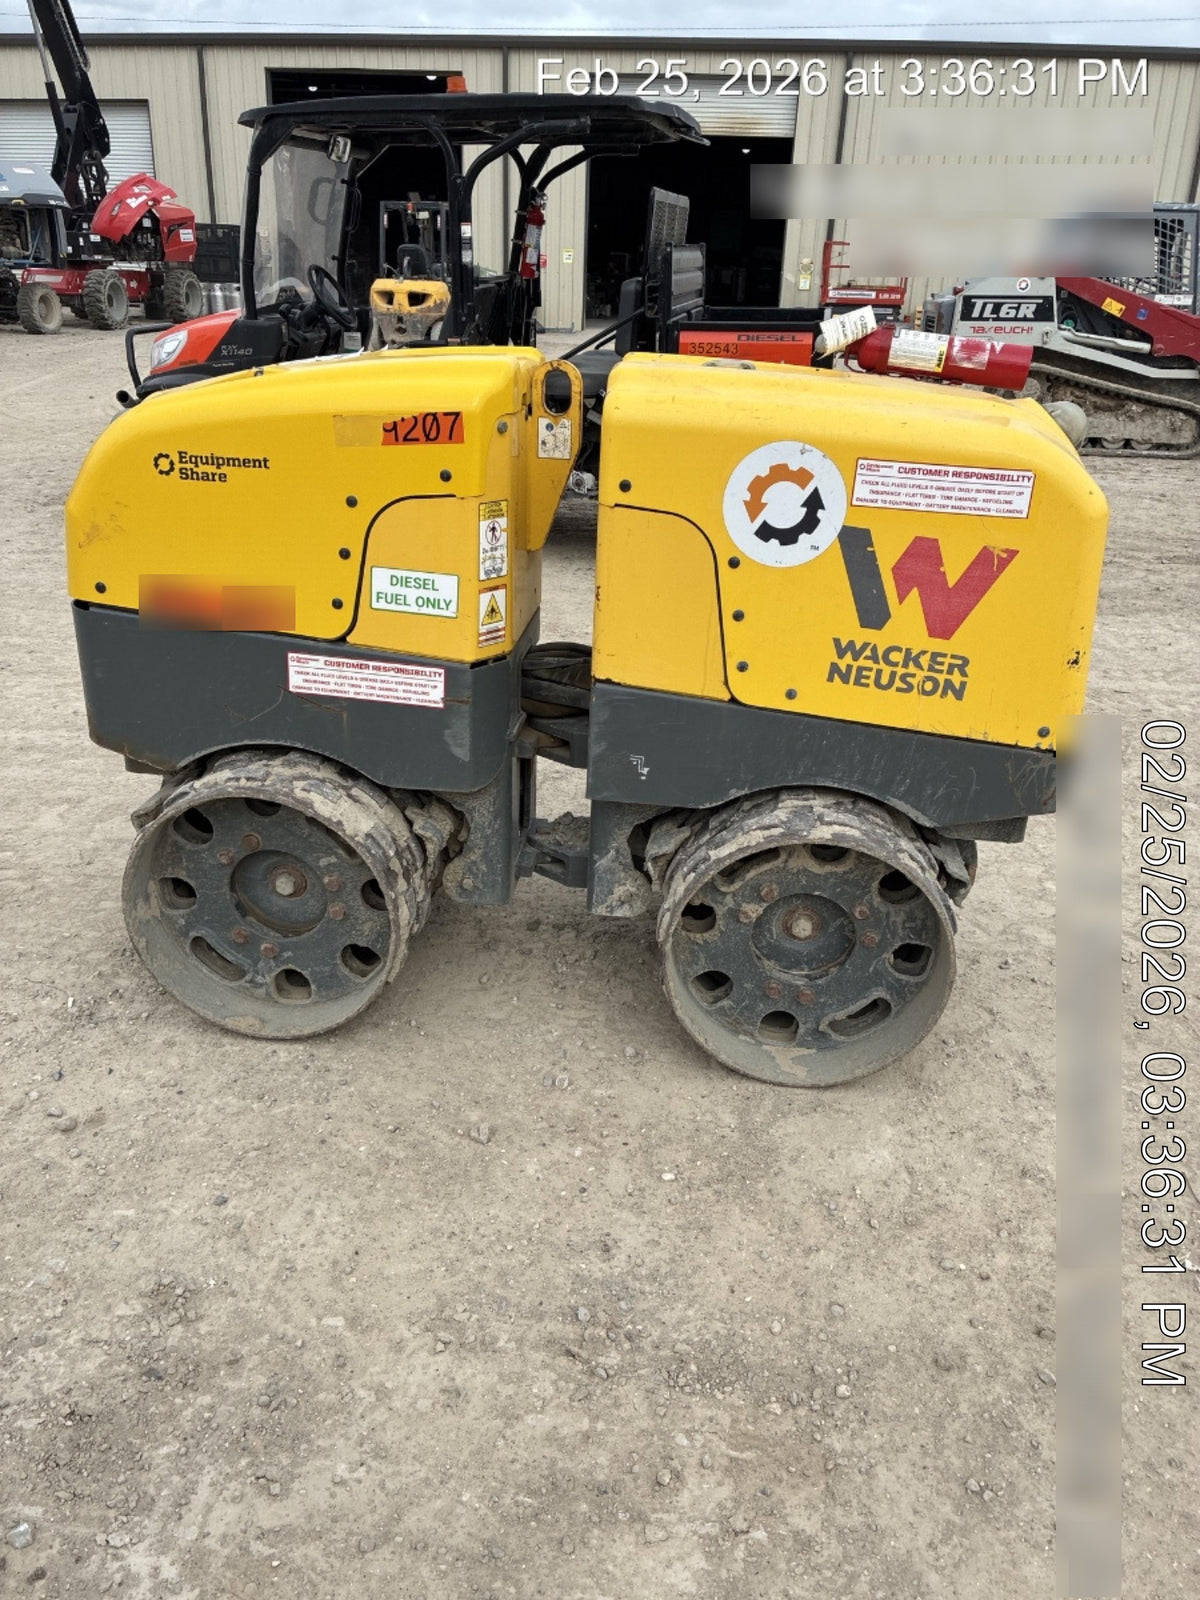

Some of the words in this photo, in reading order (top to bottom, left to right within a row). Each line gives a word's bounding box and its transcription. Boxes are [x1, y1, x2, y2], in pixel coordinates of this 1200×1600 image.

[971, 299, 1044, 318] TL6R
[737, 334, 804, 342] DIESEL
[688, 342, 738, 355] 352543
[177, 451, 270, 470] Equipment
[179, 467, 228, 483] Share
[897, 466, 950, 478] CUSTOMER
[951, 470, 1032, 483] RESPONSIBILITY
[390, 575, 439, 591] DIESEL
[376, 592, 411, 606] FUEL
[416, 596, 452, 611] ONLY
[832, 637, 970, 678] WACKER
[324, 659, 370, 671] CUSTOMER
[372, 664, 443, 678] RESPONSIBILITY
[826, 662, 967, 701] NEUSON
